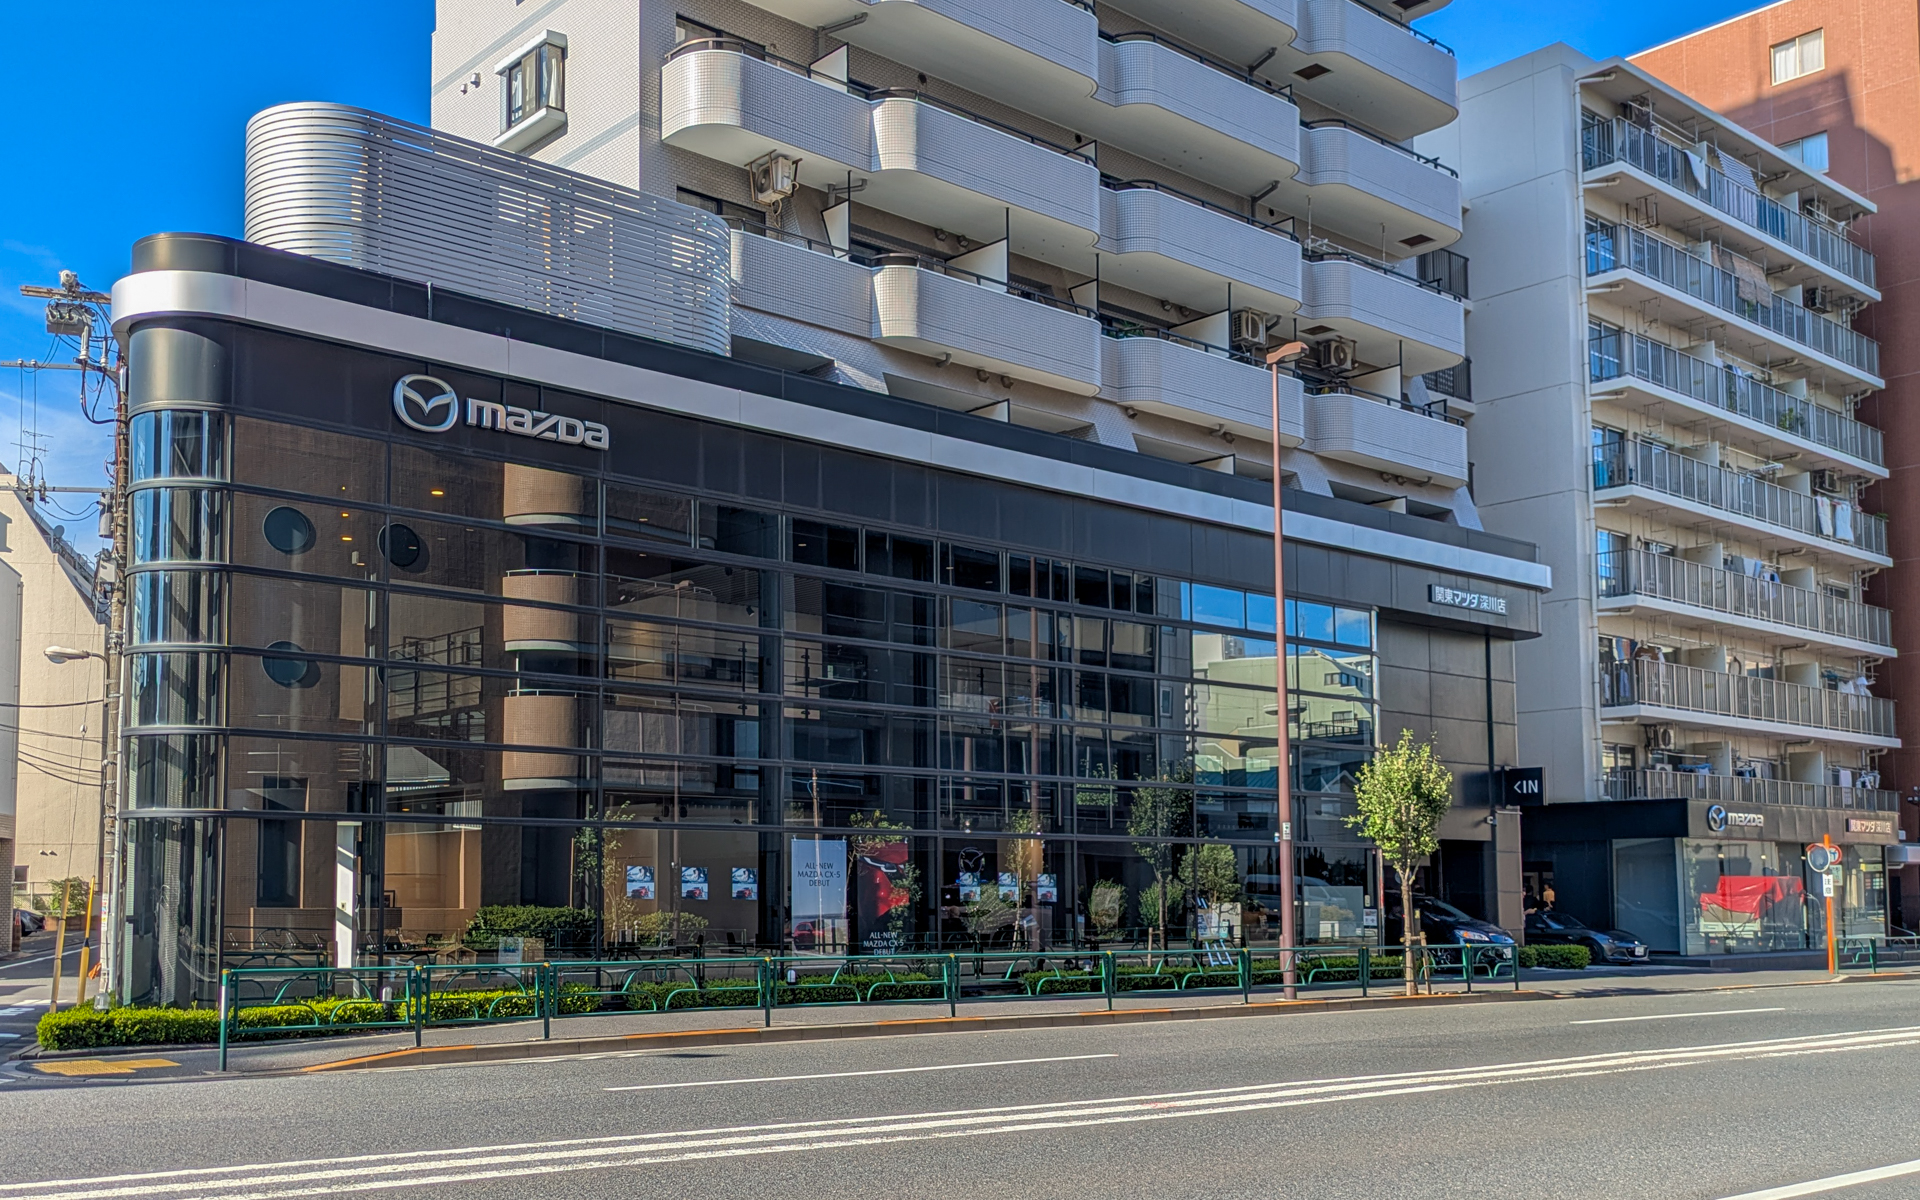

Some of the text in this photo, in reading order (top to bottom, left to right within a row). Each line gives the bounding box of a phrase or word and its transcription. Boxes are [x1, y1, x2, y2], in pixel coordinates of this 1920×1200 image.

[1522, 779, 1539, 794] IN
[804, 862, 834, 870] ALL-NEW
[824, 870, 841, 878] CX-5
[808, 879, 830, 887] DEBUT
[869, 931, 898, 939] ALL-NEW
[863, 940, 888, 948] MAZDA
[873, 948, 895, 956] DEBUT
